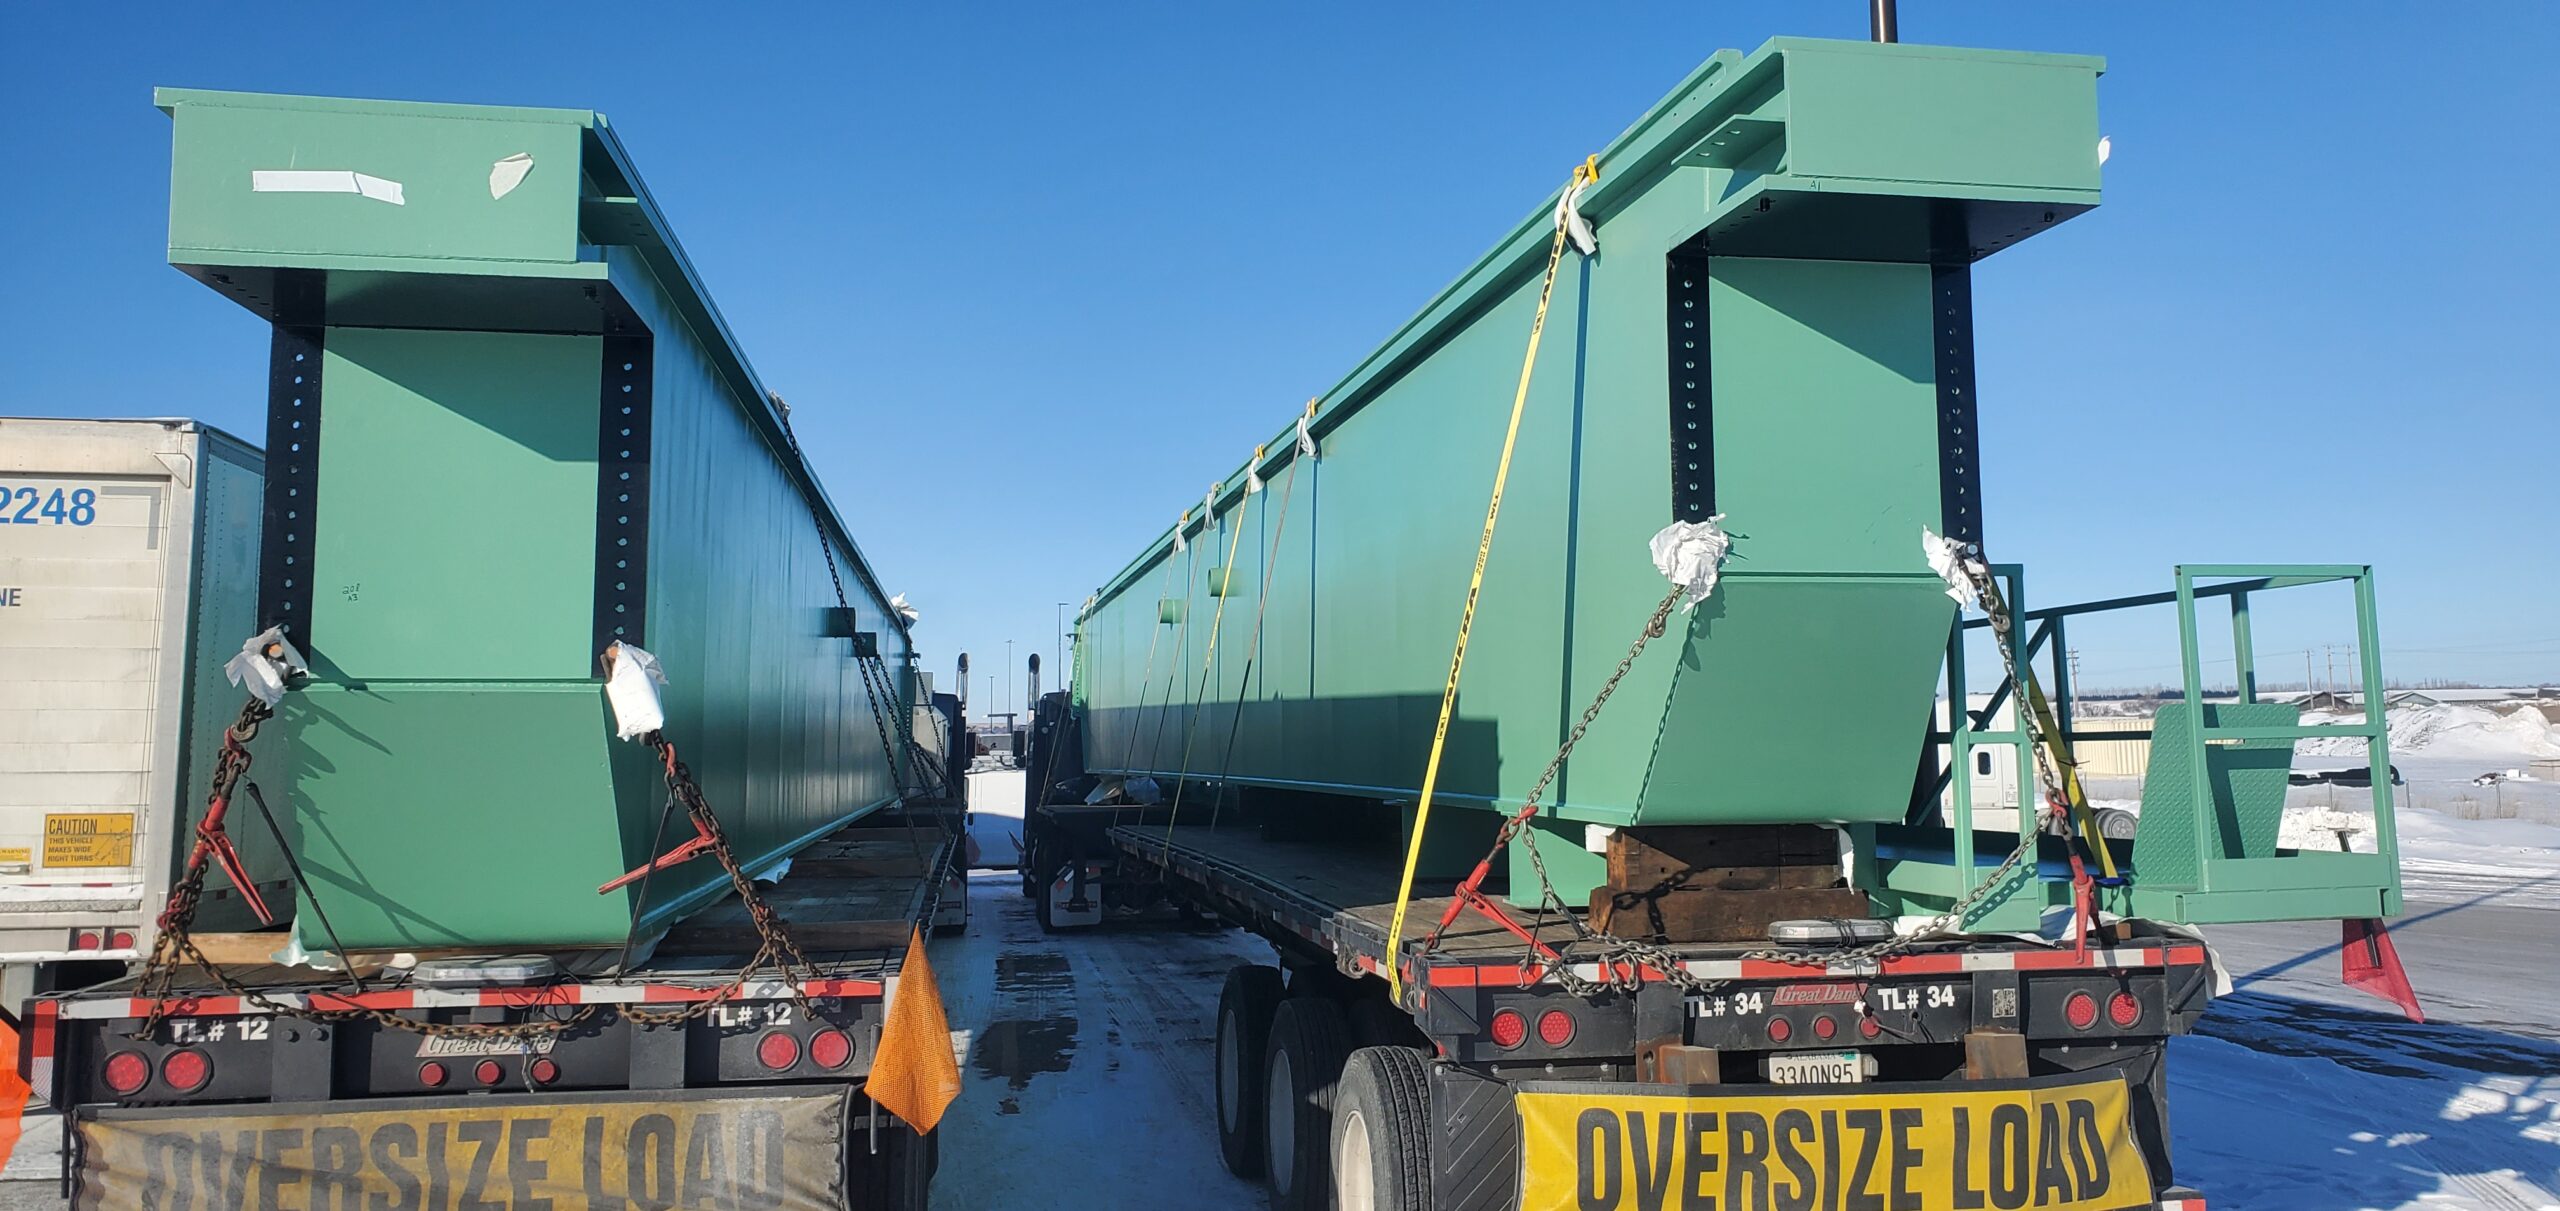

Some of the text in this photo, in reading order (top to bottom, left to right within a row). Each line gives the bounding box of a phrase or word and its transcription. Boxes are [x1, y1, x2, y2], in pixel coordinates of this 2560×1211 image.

[1542, 207, 1568, 306] ANCR
[1445, 587, 1478, 713] ANCRA
[49, 818, 97, 835] CAUTION
[49, 836, 94, 845] THIS VEHICLE
[74, 845, 92, 853] WIDE
[1684, 991, 1763, 1018] TL# 34
[1777, 984, 1823, 1003] Great
[1877, 984, 1956, 1011] TL# 34
[763, 1002, 793, 1026] 12
[169, 1015, 270, 1043] TL# 12
[1793, 1052, 1837, 1062] ALABAMA
[141, 1110, 786, 1211] OVERSIZE LOAD
[1577, 1099, 2112, 1211] OVERSIZE LOAD
